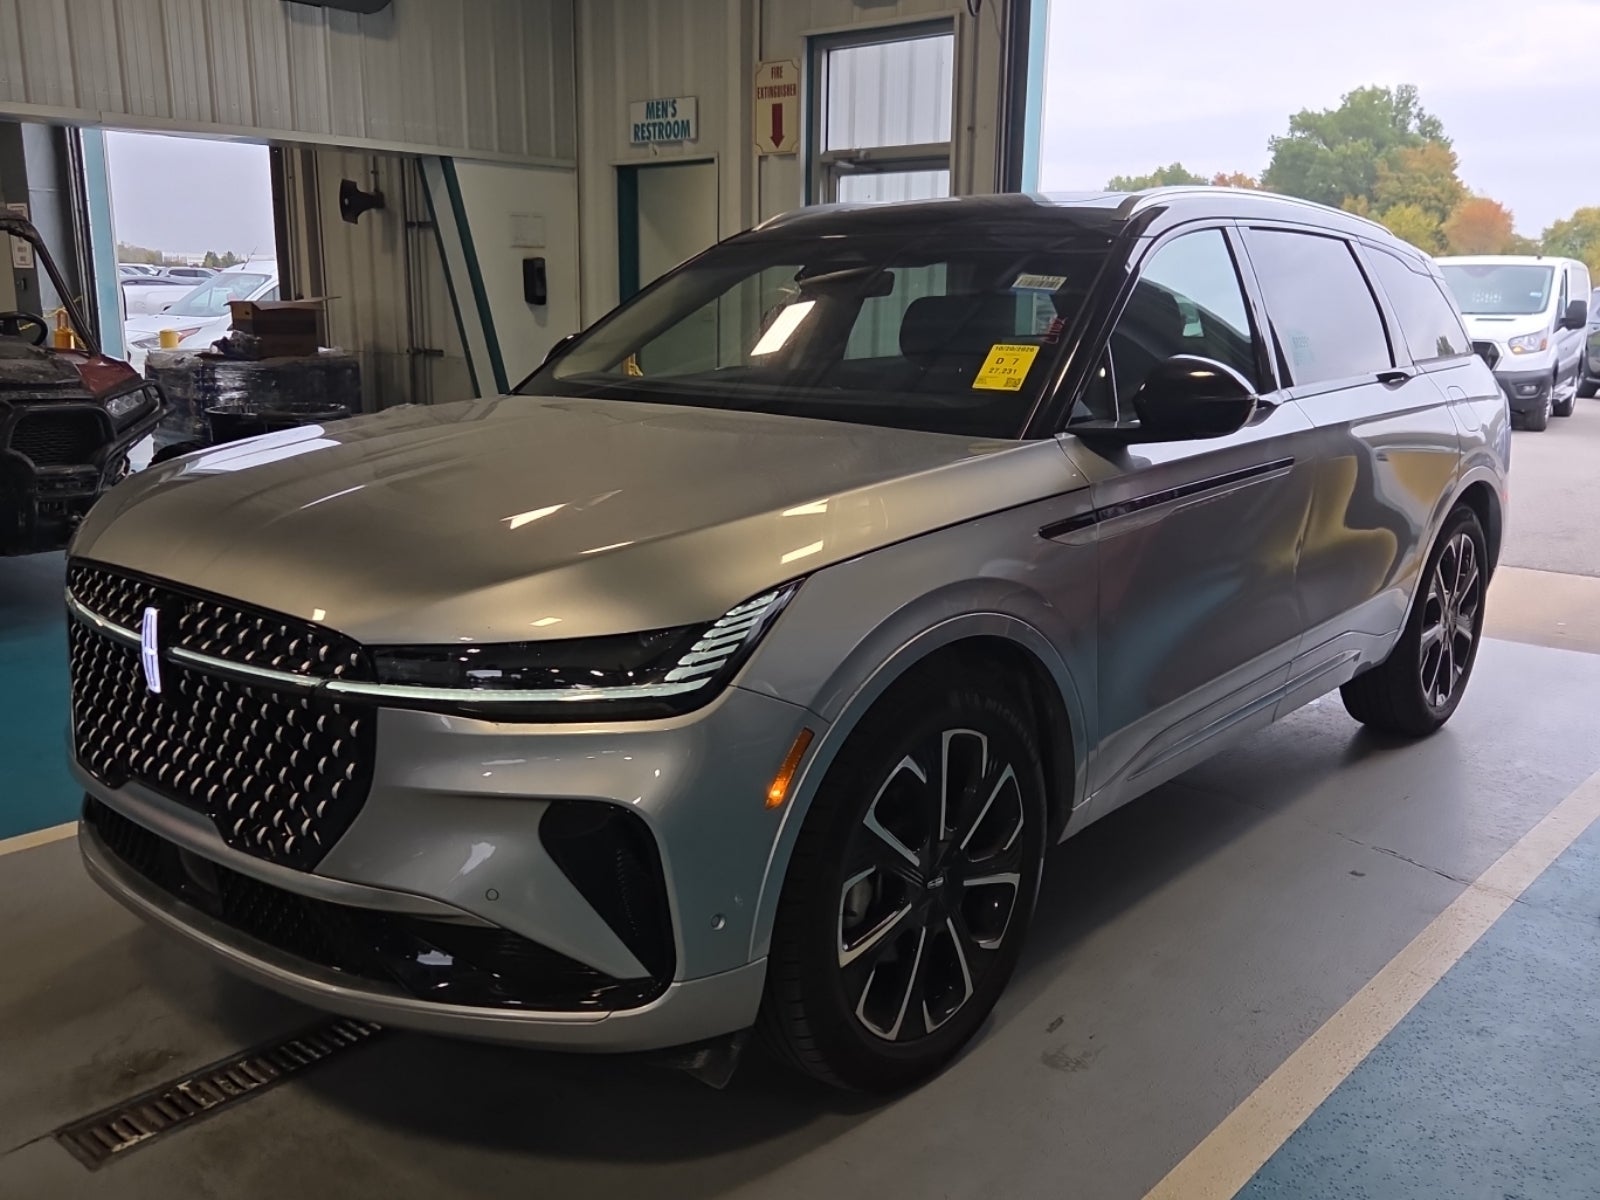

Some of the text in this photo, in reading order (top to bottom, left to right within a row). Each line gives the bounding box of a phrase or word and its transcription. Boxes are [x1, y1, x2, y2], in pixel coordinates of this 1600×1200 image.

[771, 65, 783, 80] FIRE
[757, 84, 797, 100] EXTINGUISHER
[645, 99, 677, 119] MEN'S
[633, 120, 691, 142] RESTROOM
[995, 357, 1020, 365] D 7
